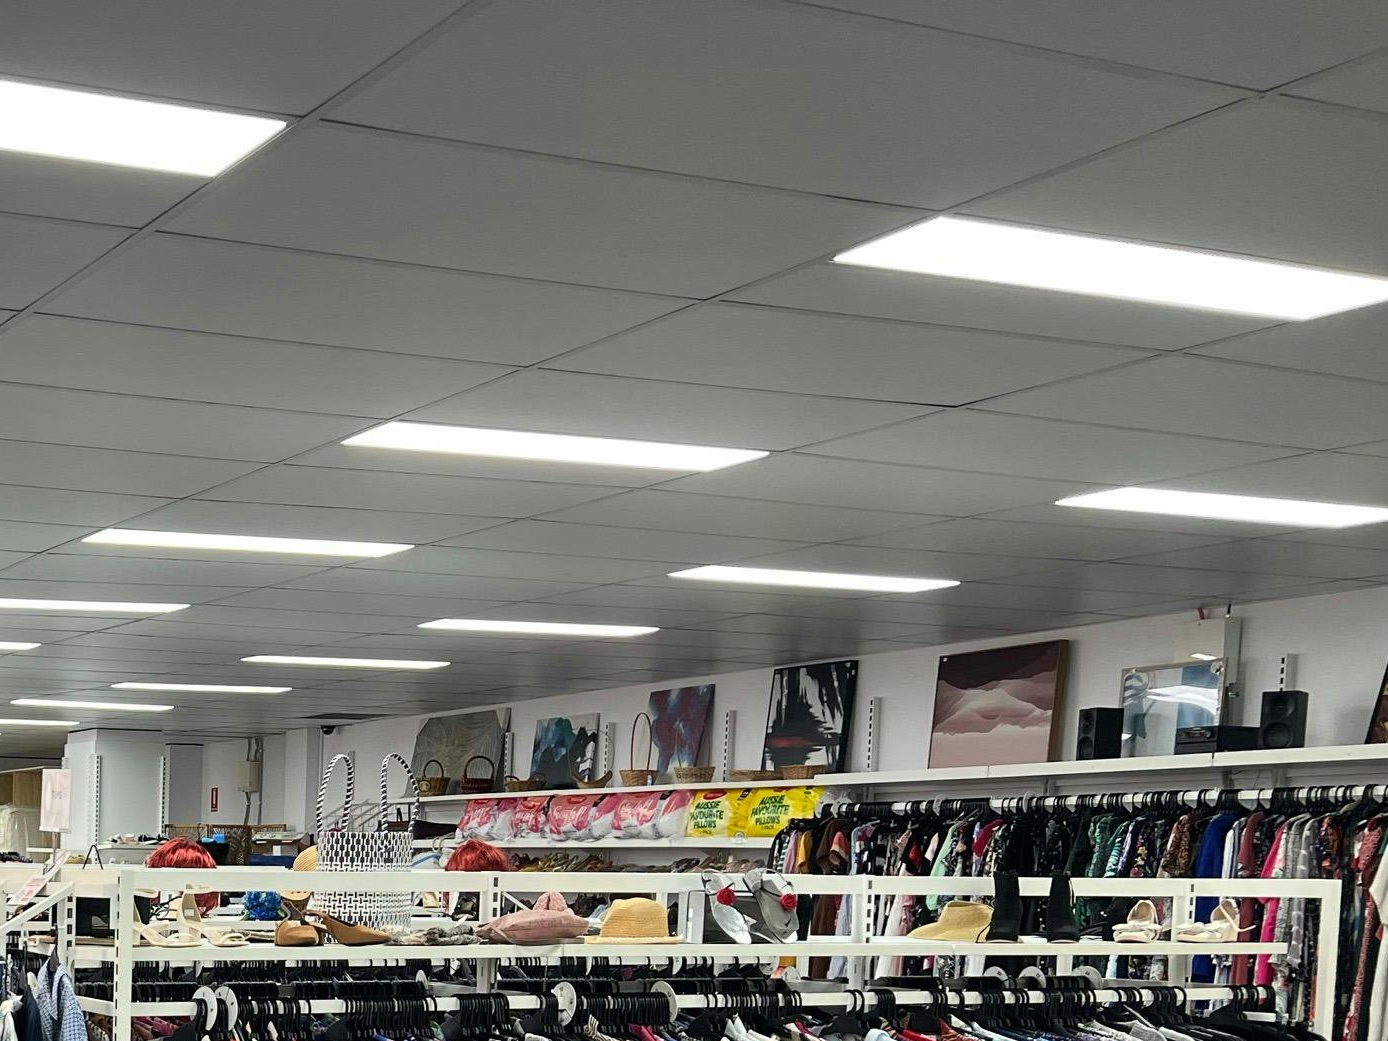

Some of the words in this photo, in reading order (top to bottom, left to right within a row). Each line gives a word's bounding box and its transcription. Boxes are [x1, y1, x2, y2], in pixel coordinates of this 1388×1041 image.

[758, 794, 786, 805] AUSSIE
[694, 800, 722, 810] AUSSIE
[693, 819, 717, 829] PILLOWS
